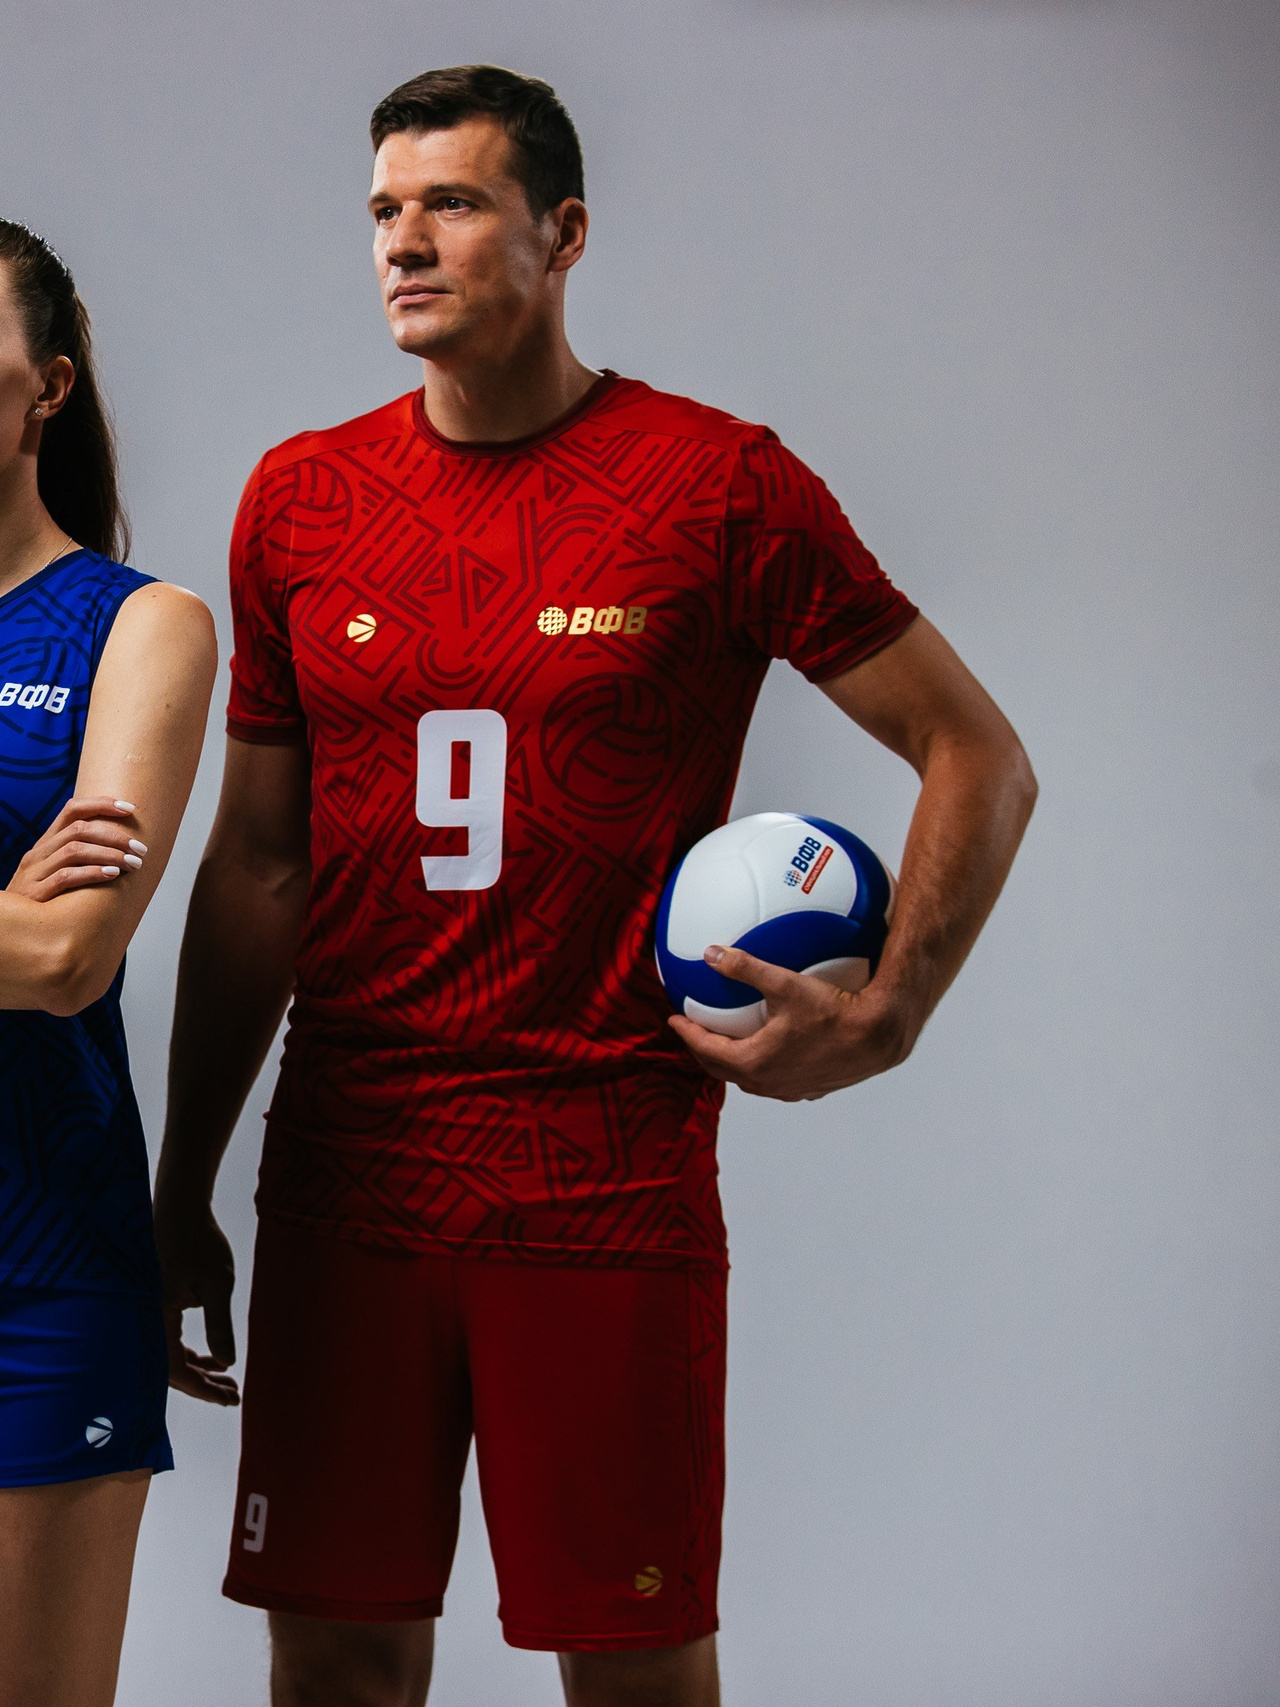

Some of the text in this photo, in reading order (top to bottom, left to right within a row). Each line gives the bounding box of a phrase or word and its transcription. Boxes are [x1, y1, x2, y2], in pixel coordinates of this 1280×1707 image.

[568, 606, 649, 635] ВФВ
[415, 708, 508, 892] 9
[790, 836, 822, 874] ВФВ
[242, 1492, 269, 1555] 9
